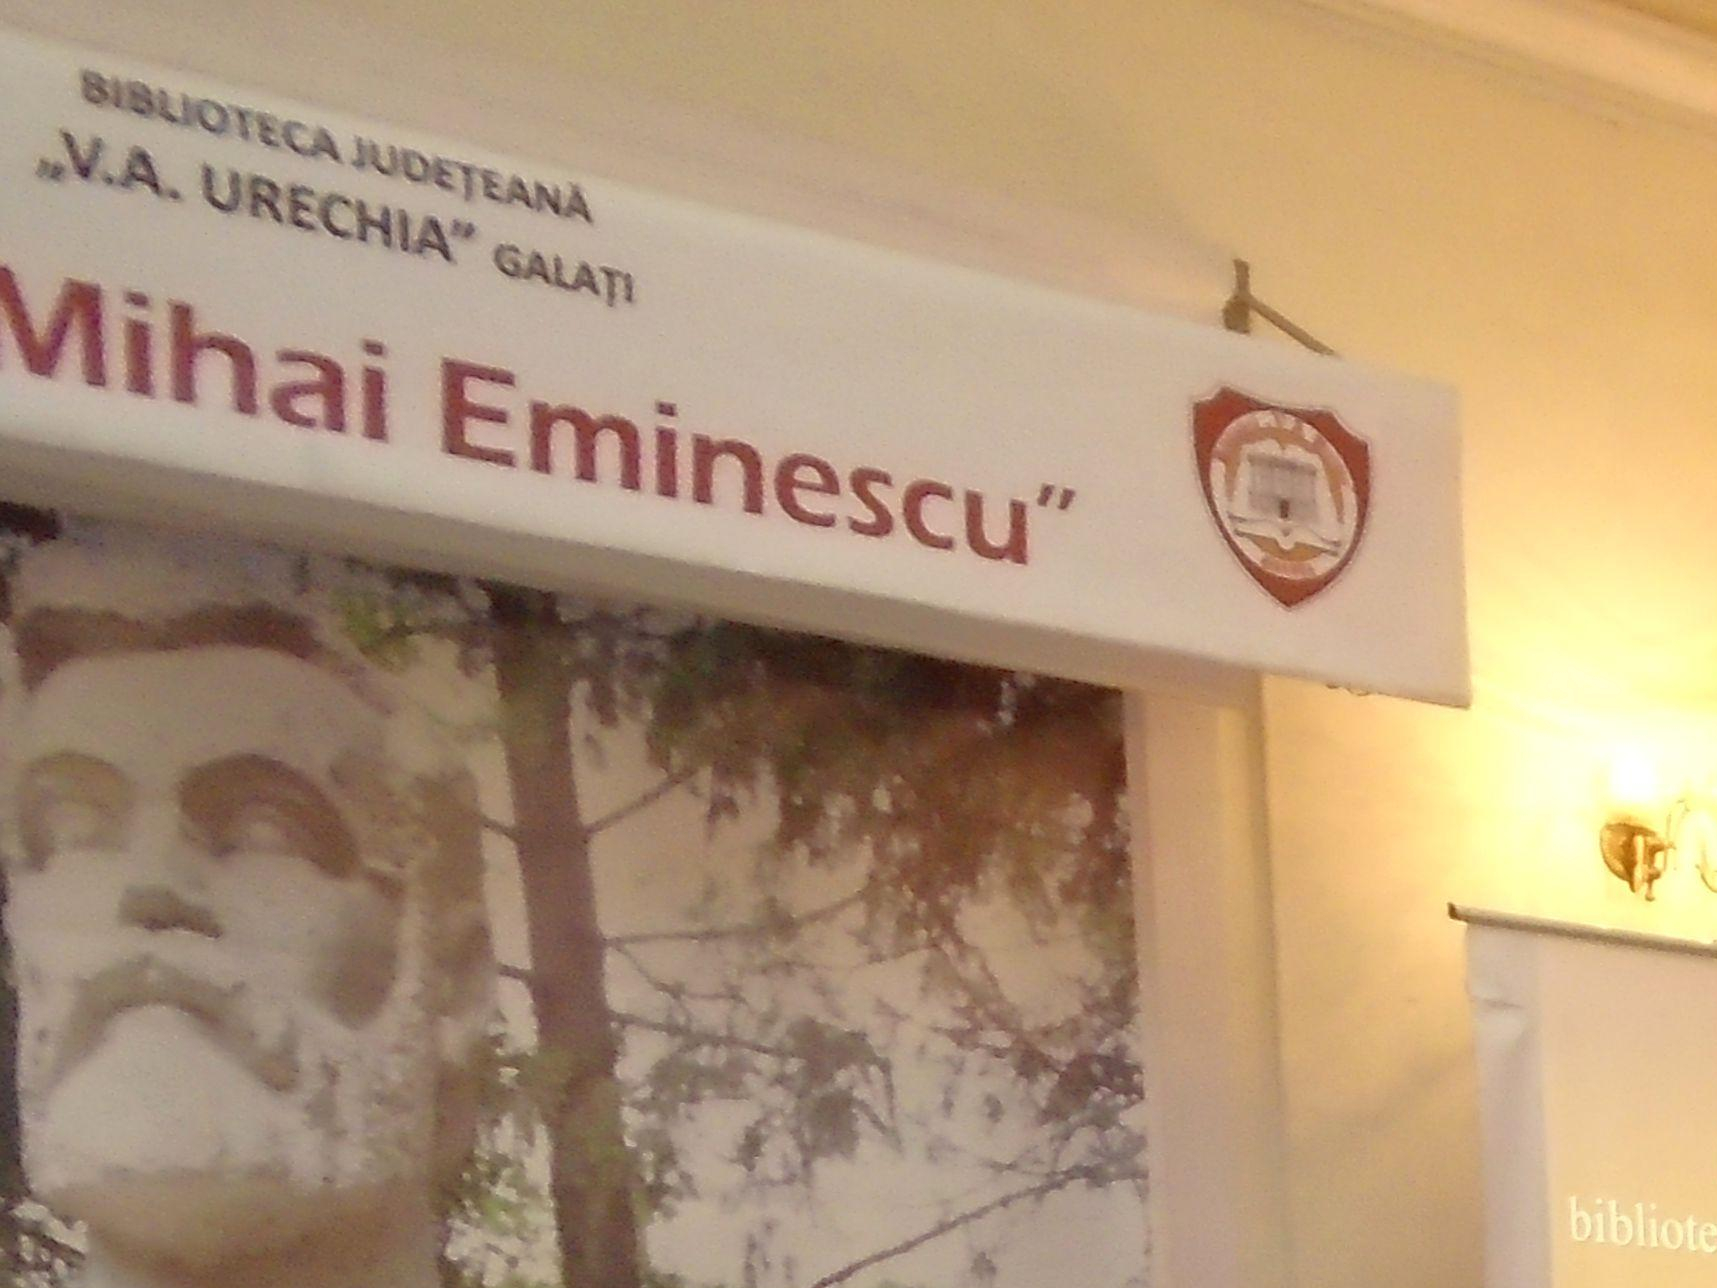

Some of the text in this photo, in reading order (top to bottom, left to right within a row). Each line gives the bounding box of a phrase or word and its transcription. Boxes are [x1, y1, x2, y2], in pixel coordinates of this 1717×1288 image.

[80, 69, 340, 164] BIBLIOTECA
[200, 164, 477, 264] URECHIA”
[492, 242, 636, 307] GALAȚI
[0, 263, 391, 443] Mihai
